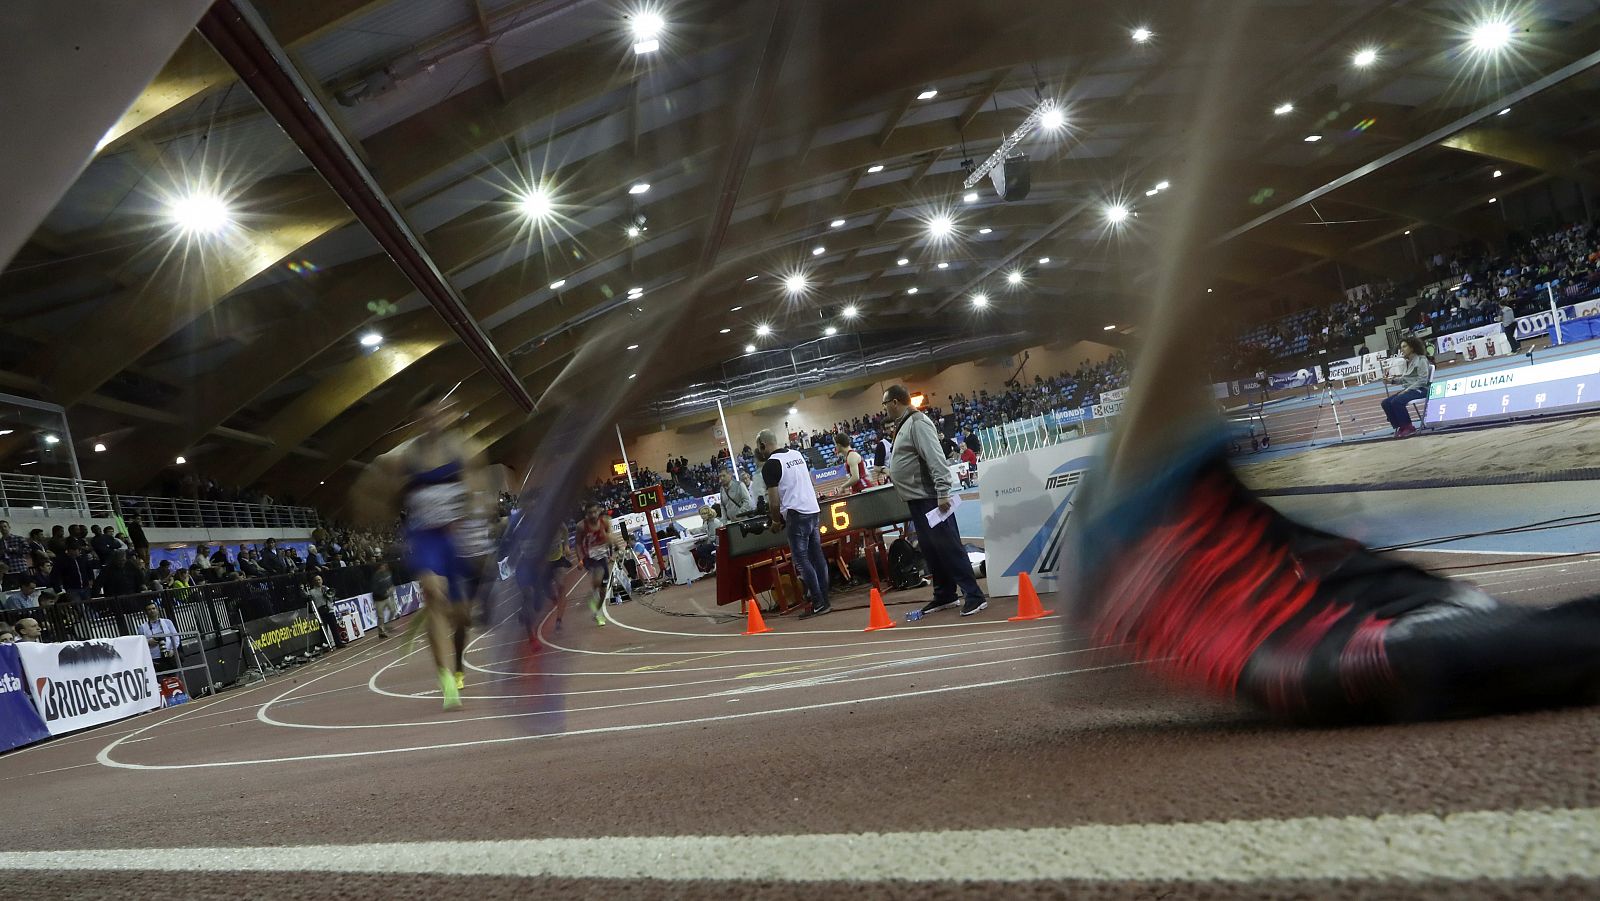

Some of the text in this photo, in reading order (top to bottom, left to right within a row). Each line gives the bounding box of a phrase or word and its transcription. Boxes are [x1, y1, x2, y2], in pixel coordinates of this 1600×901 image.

[1517, 307, 1568, 335] oma
[1470, 373, 1514, 389] ULLMAN
[1502, 394, 1510, 407] 6
[1056, 407, 1085, 420] MONDO
[815, 469, 838, 480] MADRID
[1045, 471, 1081, 490] MEE
[1001, 486, 1022, 496] MADRID
[638, 491, 657, 507] 04
[677, 503, 698, 512] MADRID
[36, 666, 152, 722] BRIDGESTONE
